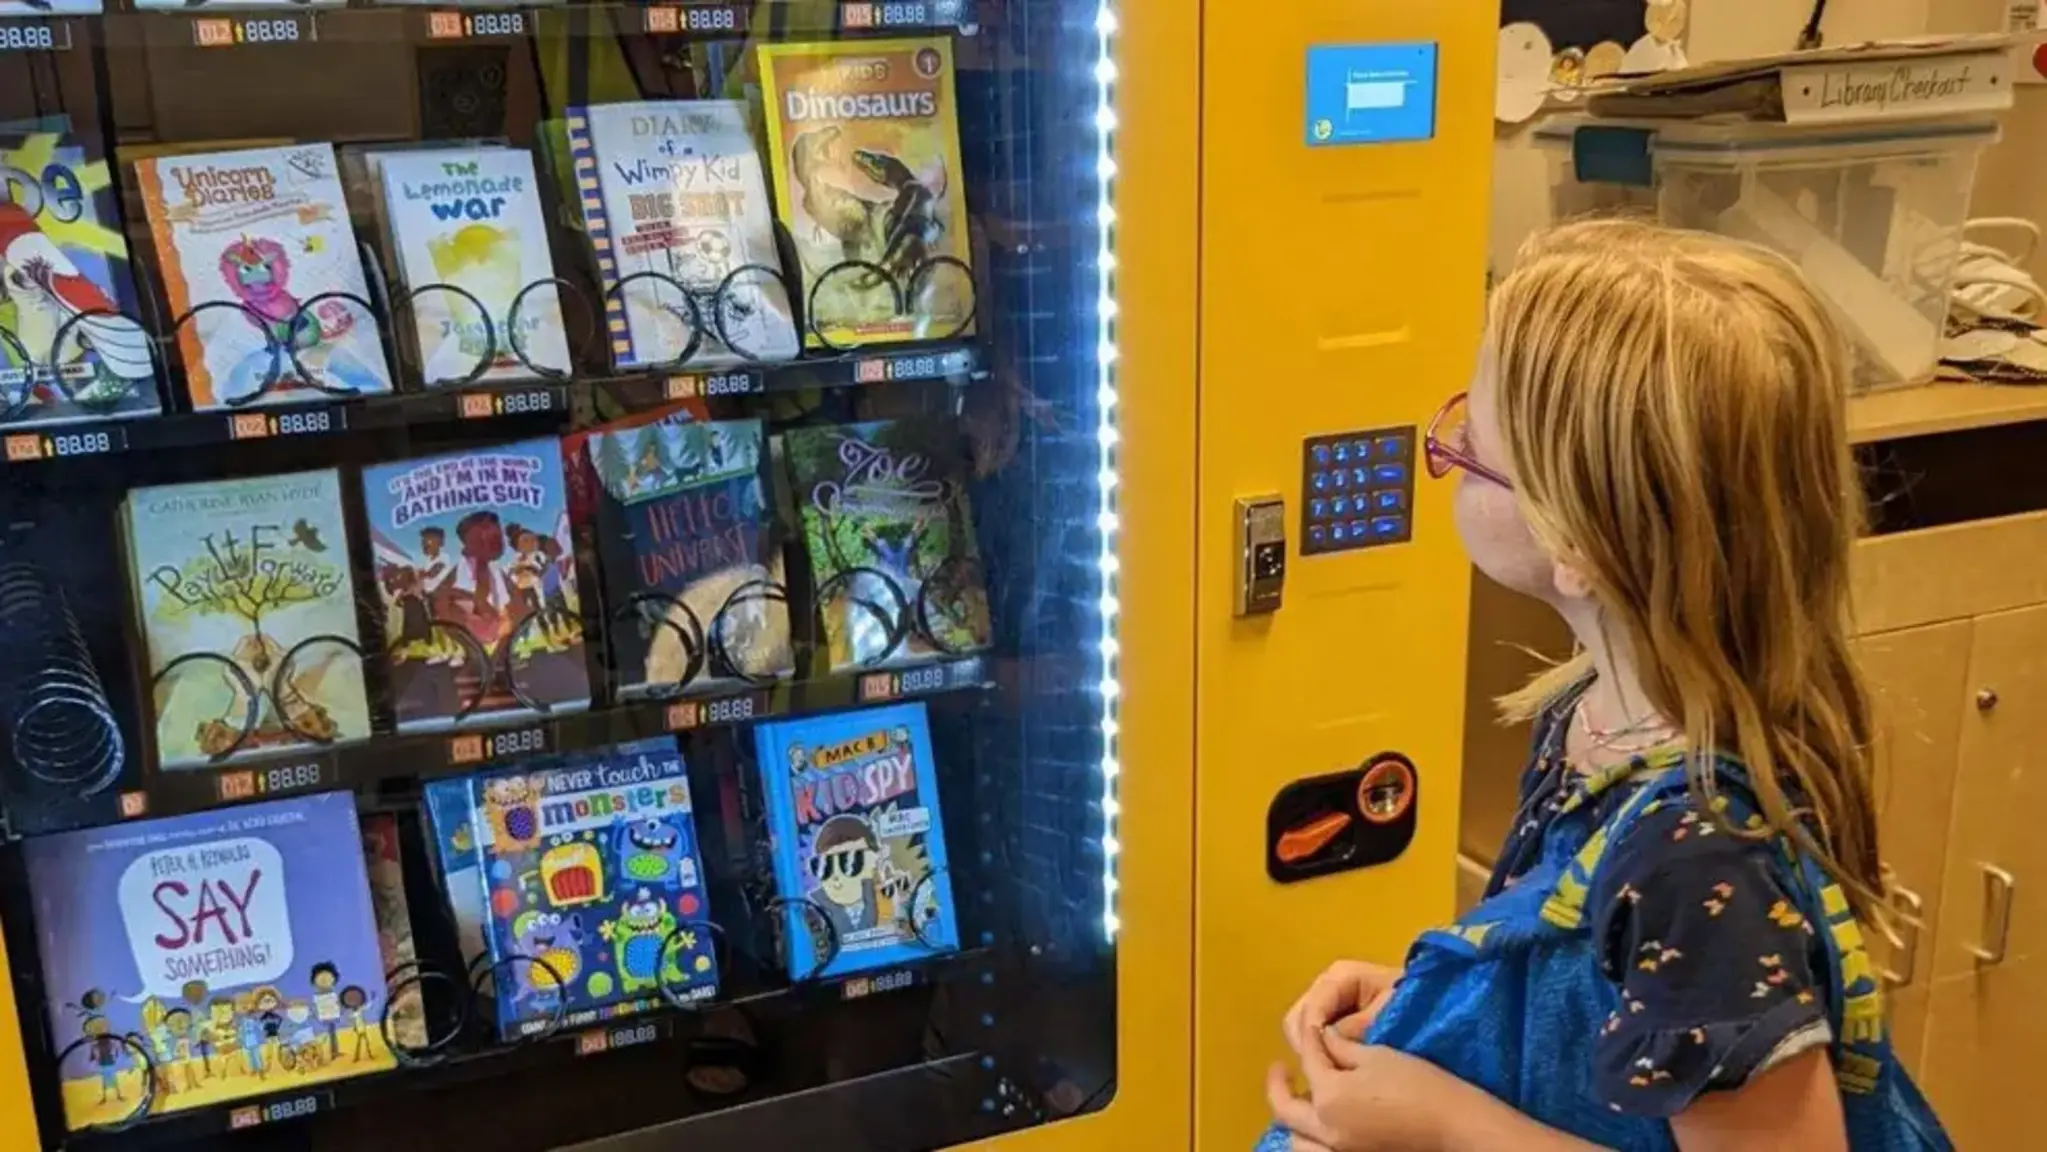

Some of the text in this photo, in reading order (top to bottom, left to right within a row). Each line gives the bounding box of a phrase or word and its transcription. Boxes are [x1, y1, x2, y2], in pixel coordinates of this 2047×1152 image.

[474, 14, 523, 35] 88.88
[690, 9, 734, 29] 88.88
[200, 20, 299, 45] 012 88.88
[1820, 65, 1971, 110] Library Checkout
[786, 86, 936, 120] Dinosaurs
[631, 114, 716, 136] DIARY
[658, 140, 675, 156] of
[170, 165, 276, 190] Unicorn
[441, 161, 479, 176] The
[613, 153, 741, 191] Wimpy Kid
[187, 184, 275, 208] Diaries
[402, 175, 523, 200] Lemonade
[430, 197, 506, 221] war
[628, 192, 676, 220] BIG
[707, 374, 749, 395] 88.88
[505, 392, 551, 413] 88.88
[280, 411, 330, 434] 88.88
[55, 432, 110, 455] 88.88
[405, 466, 529, 500] AND I'M IN MY
[395, 483, 542, 525] BATHING SUIT
[199, 528, 242, 581] It
[251, 525, 344, 598] Forward
[146, 564, 214, 606] Pay
[710, 699, 753, 722] 88.88
[495, 728, 544, 753] 88.88
[825, 741, 861, 764] MAC
[268, 764, 321, 790] 88.88
[549, 754, 681, 793] NEVER touch THE
[795, 753, 912, 825] KID SPY
[543, 784, 686, 826] monsters
[152, 868, 262, 950] SAY
[165, 943, 272, 981] SOMETHING!
